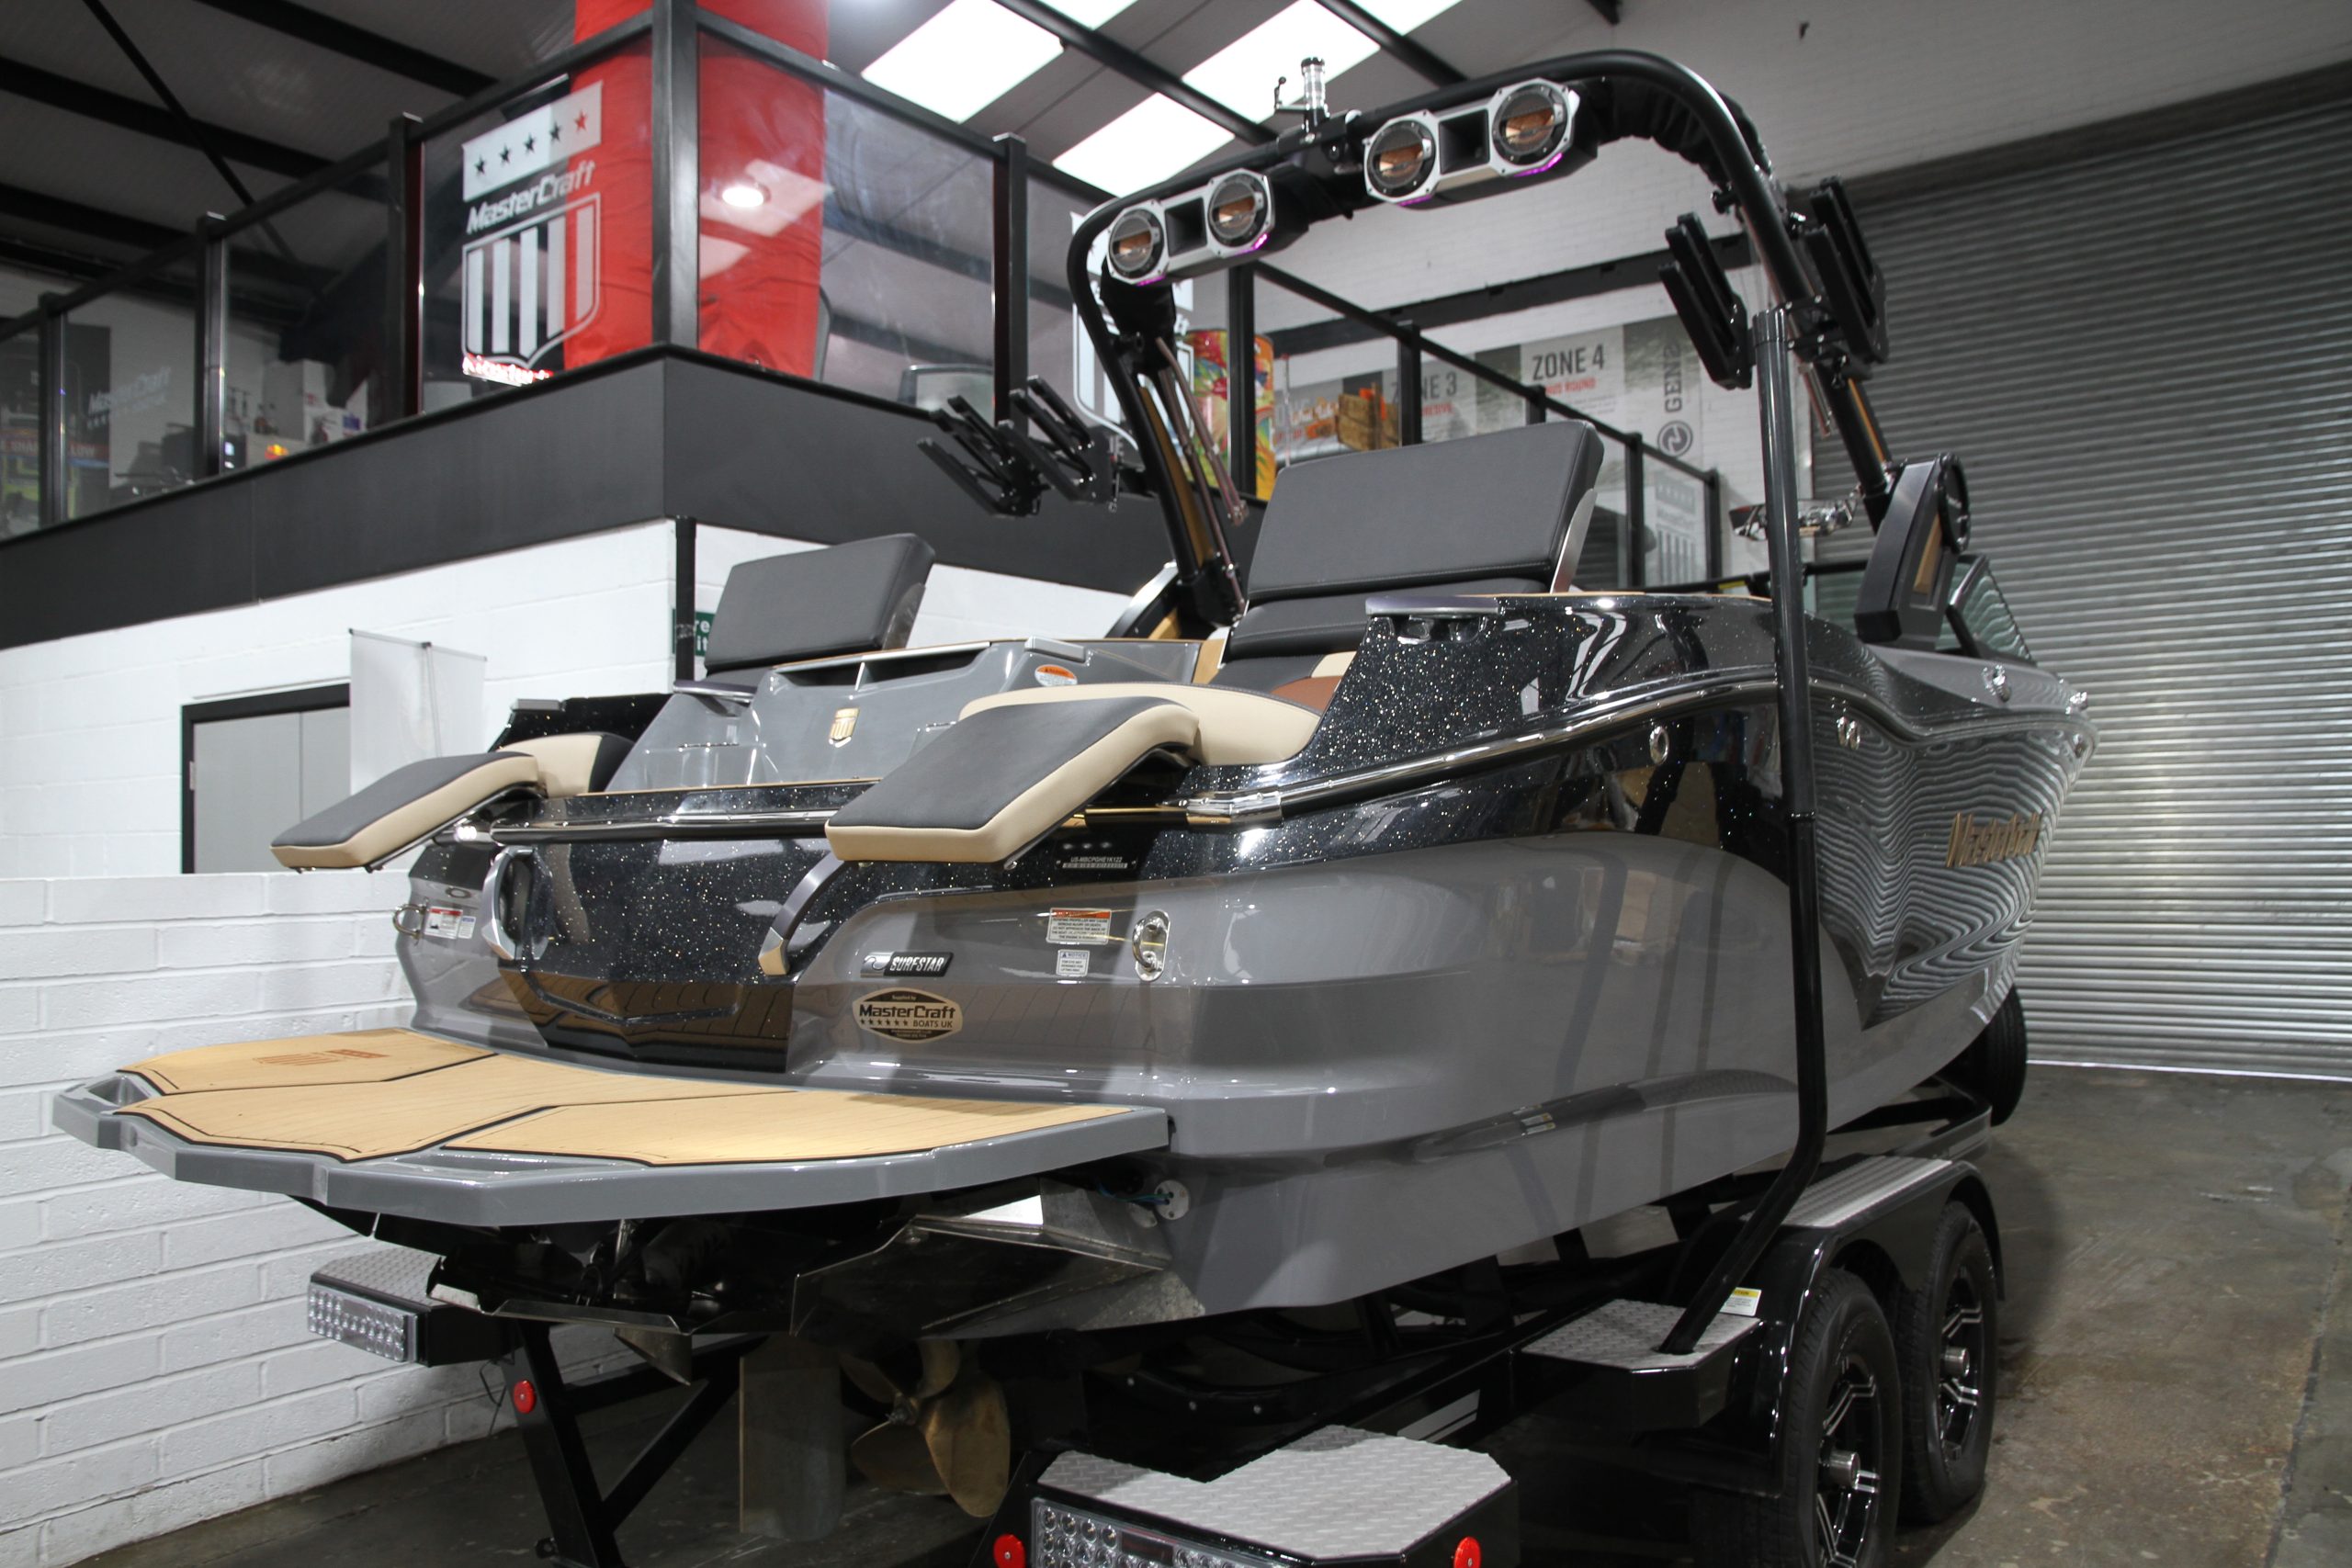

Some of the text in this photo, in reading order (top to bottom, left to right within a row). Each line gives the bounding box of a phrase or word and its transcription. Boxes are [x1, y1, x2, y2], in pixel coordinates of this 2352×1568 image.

[466, 160, 596, 235] MasterCraft
[1532, 343, 1604, 381] ZONE 4
[1445, 370, 1457, 397] 3
[889, 956, 945, 972] SURFSTAR
[859, 1004, 956, 1019] MasterCraft
[912, 1020, 953, 1029] BOATS UK
